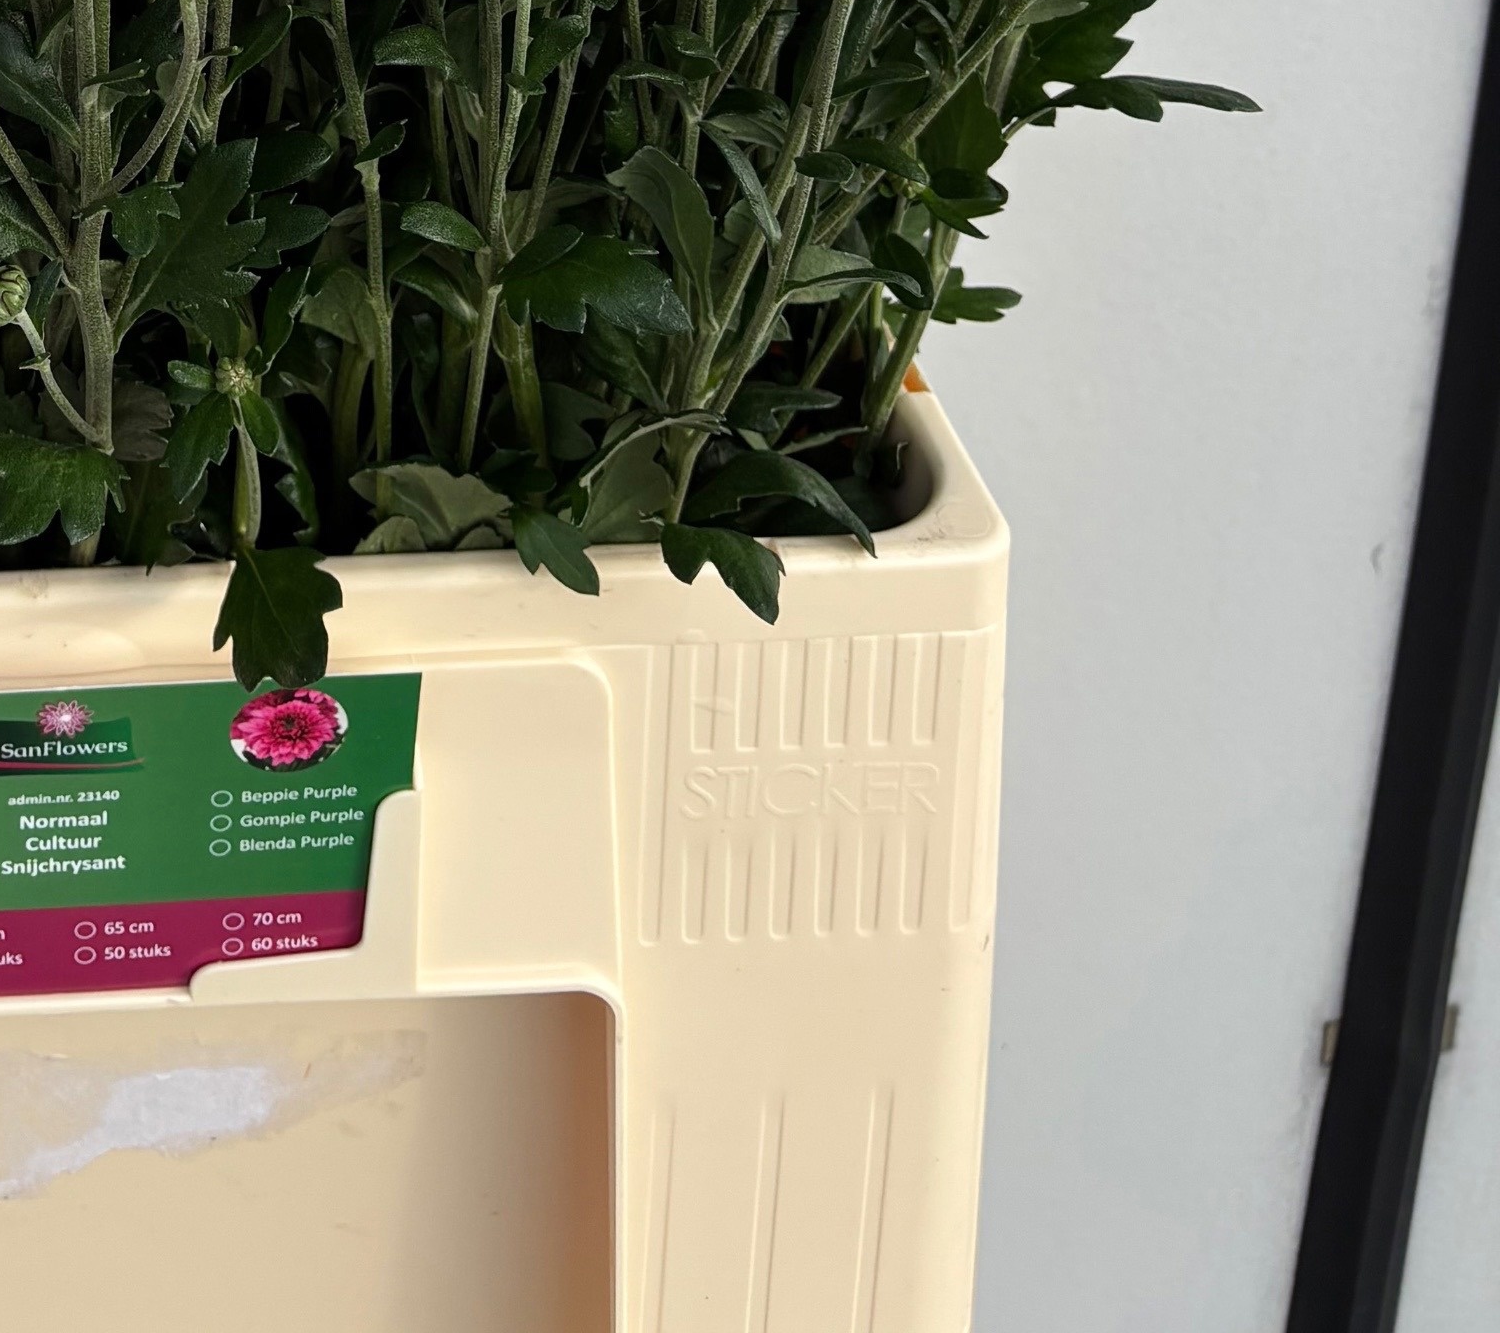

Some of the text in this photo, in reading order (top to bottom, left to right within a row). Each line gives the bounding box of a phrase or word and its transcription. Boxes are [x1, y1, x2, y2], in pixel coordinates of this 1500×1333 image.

[0, 739, 128, 760] SanFlowers
[8, 790, 120, 806] admin.nr. 23140
[241, 785, 358, 804] Beppie Purple
[679, 762, 940, 819] STICKER
[19, 810, 109, 831] Normaal
[240, 808, 364, 828] Gompie Purple
[25, 836, 103, 852] Cultuur
[240, 834, 355, 852] Blenda Purple
[0, 854, 127, 877] Snijchrysant
[104, 921, 154, 934] 65 cm
[253, 912, 302, 925] 70 cm
[251, 935, 318, 950] 60 stuks
[104, 944, 171, 960] 50 stuks
